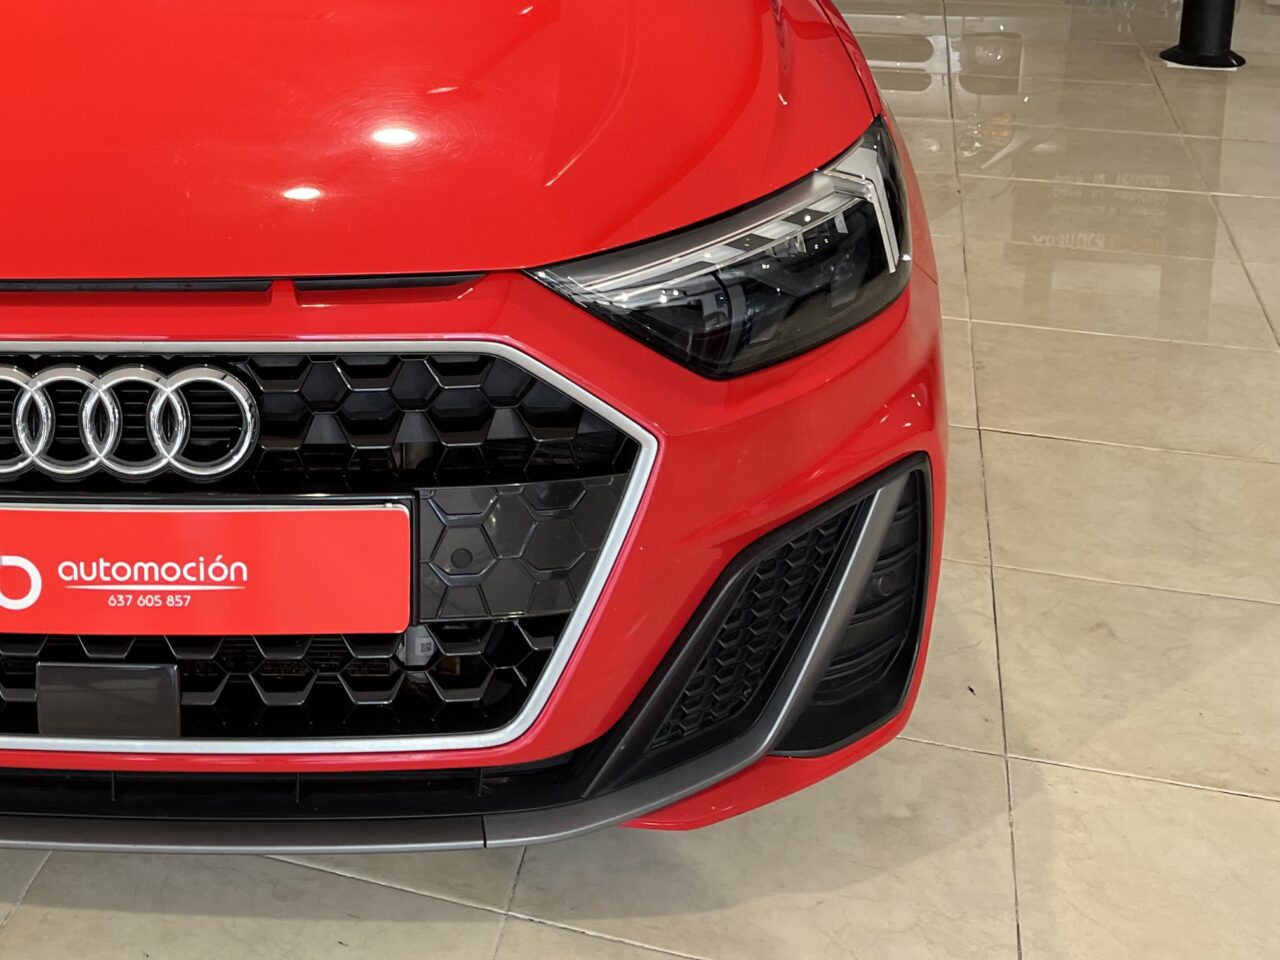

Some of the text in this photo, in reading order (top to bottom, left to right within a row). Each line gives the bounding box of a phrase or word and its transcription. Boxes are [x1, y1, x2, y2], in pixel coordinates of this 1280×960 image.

[57, 555, 248, 582] automoción
[107, 594, 191, 607] 637 605 857
